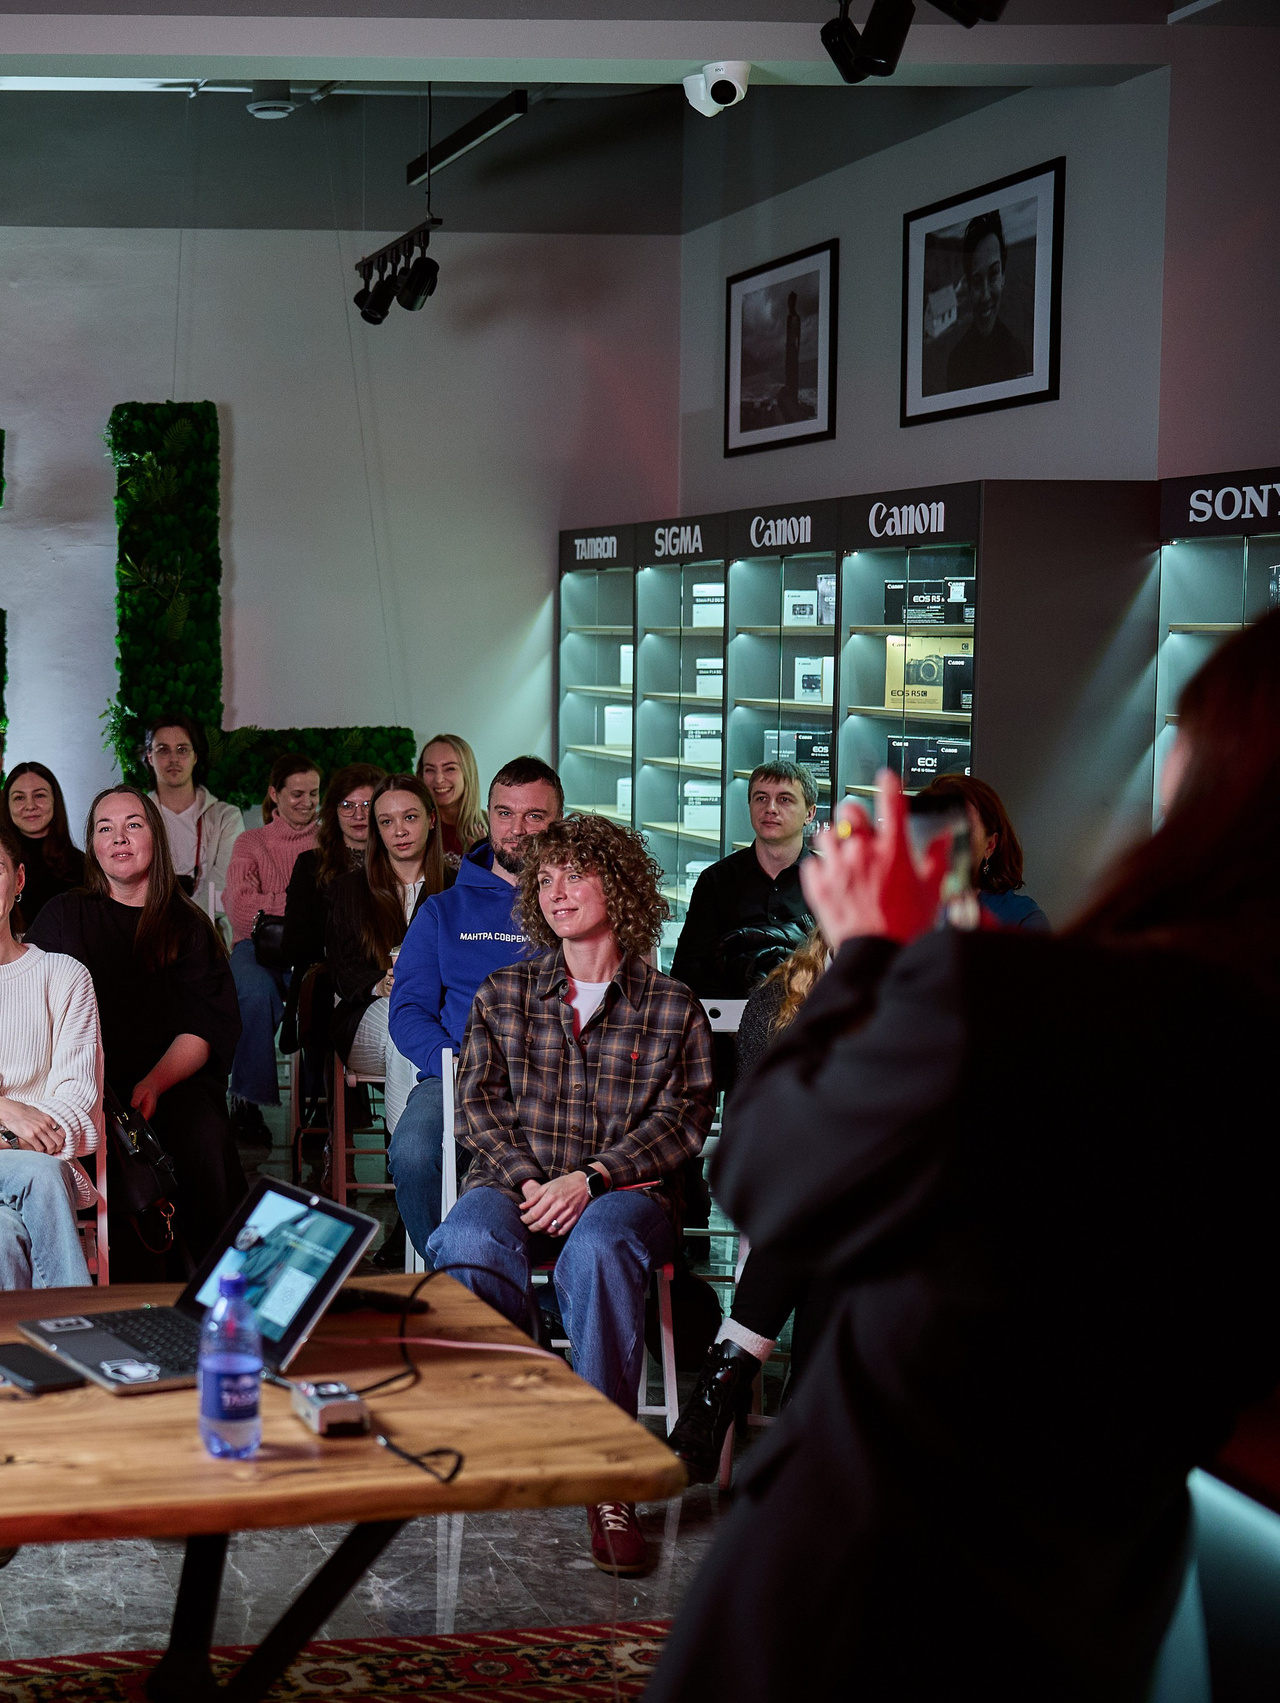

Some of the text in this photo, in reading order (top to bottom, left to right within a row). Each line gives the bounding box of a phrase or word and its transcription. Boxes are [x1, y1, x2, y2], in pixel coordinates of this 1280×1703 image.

[750, 515, 812, 548] Canon
[868, 501, 945, 538] Canon
[574, 536, 618, 560] TAMRON
[654, 524, 703, 557] SIGMA
[912, 595, 931, 603] EOS
[890, 689, 910, 697] EOS
[459, 932, 528, 943] МАНТРА СОВРЕМ
